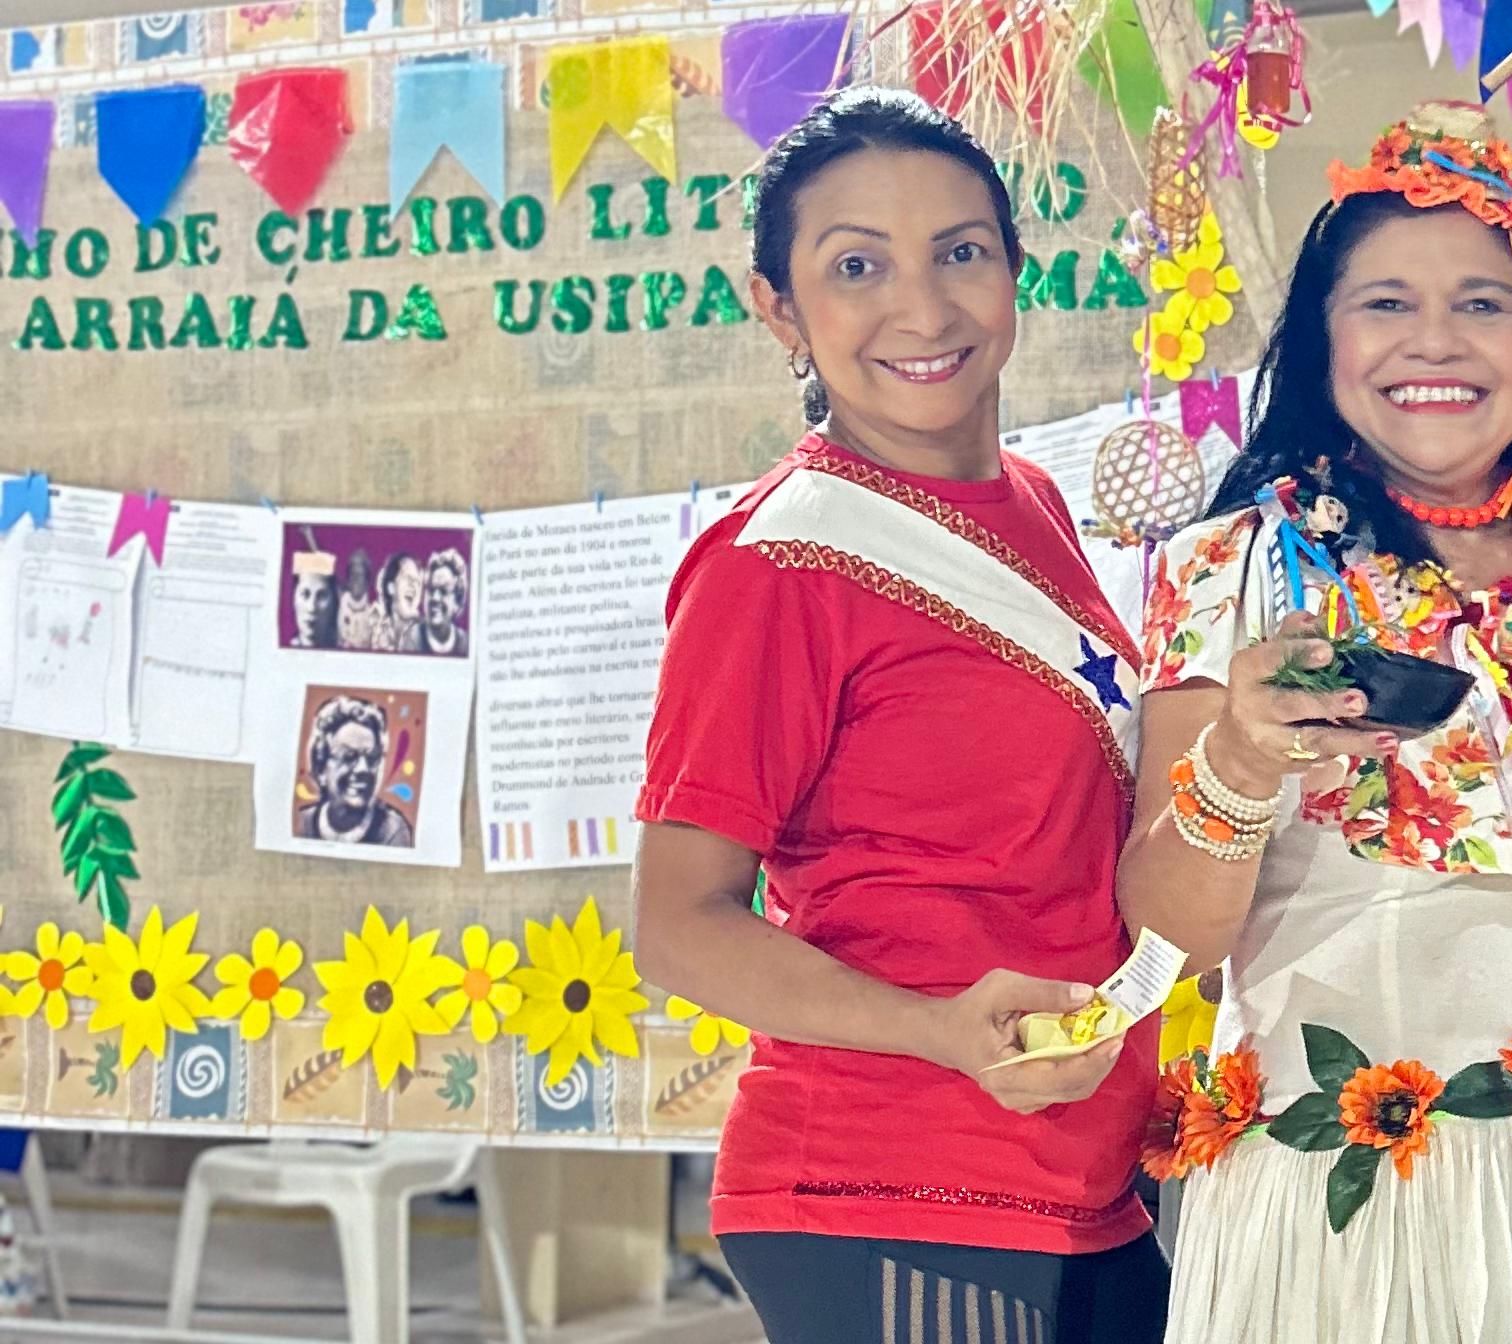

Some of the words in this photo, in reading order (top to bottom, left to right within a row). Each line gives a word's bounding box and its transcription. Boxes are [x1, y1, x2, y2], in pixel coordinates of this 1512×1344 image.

[0, 227, 110, 280] HO
[133, 211, 221, 273] DE
[256, 194, 545, 266] CHEIRO
[12, 264, 309, 351] ARRAIÁ
[341, 283, 448, 342] DA
[492, 264, 757, 335] USIPA
[636, 615, 663, 627] brasil
[635, 711, 654, 720] sen
[630, 772, 644, 783] Gr
